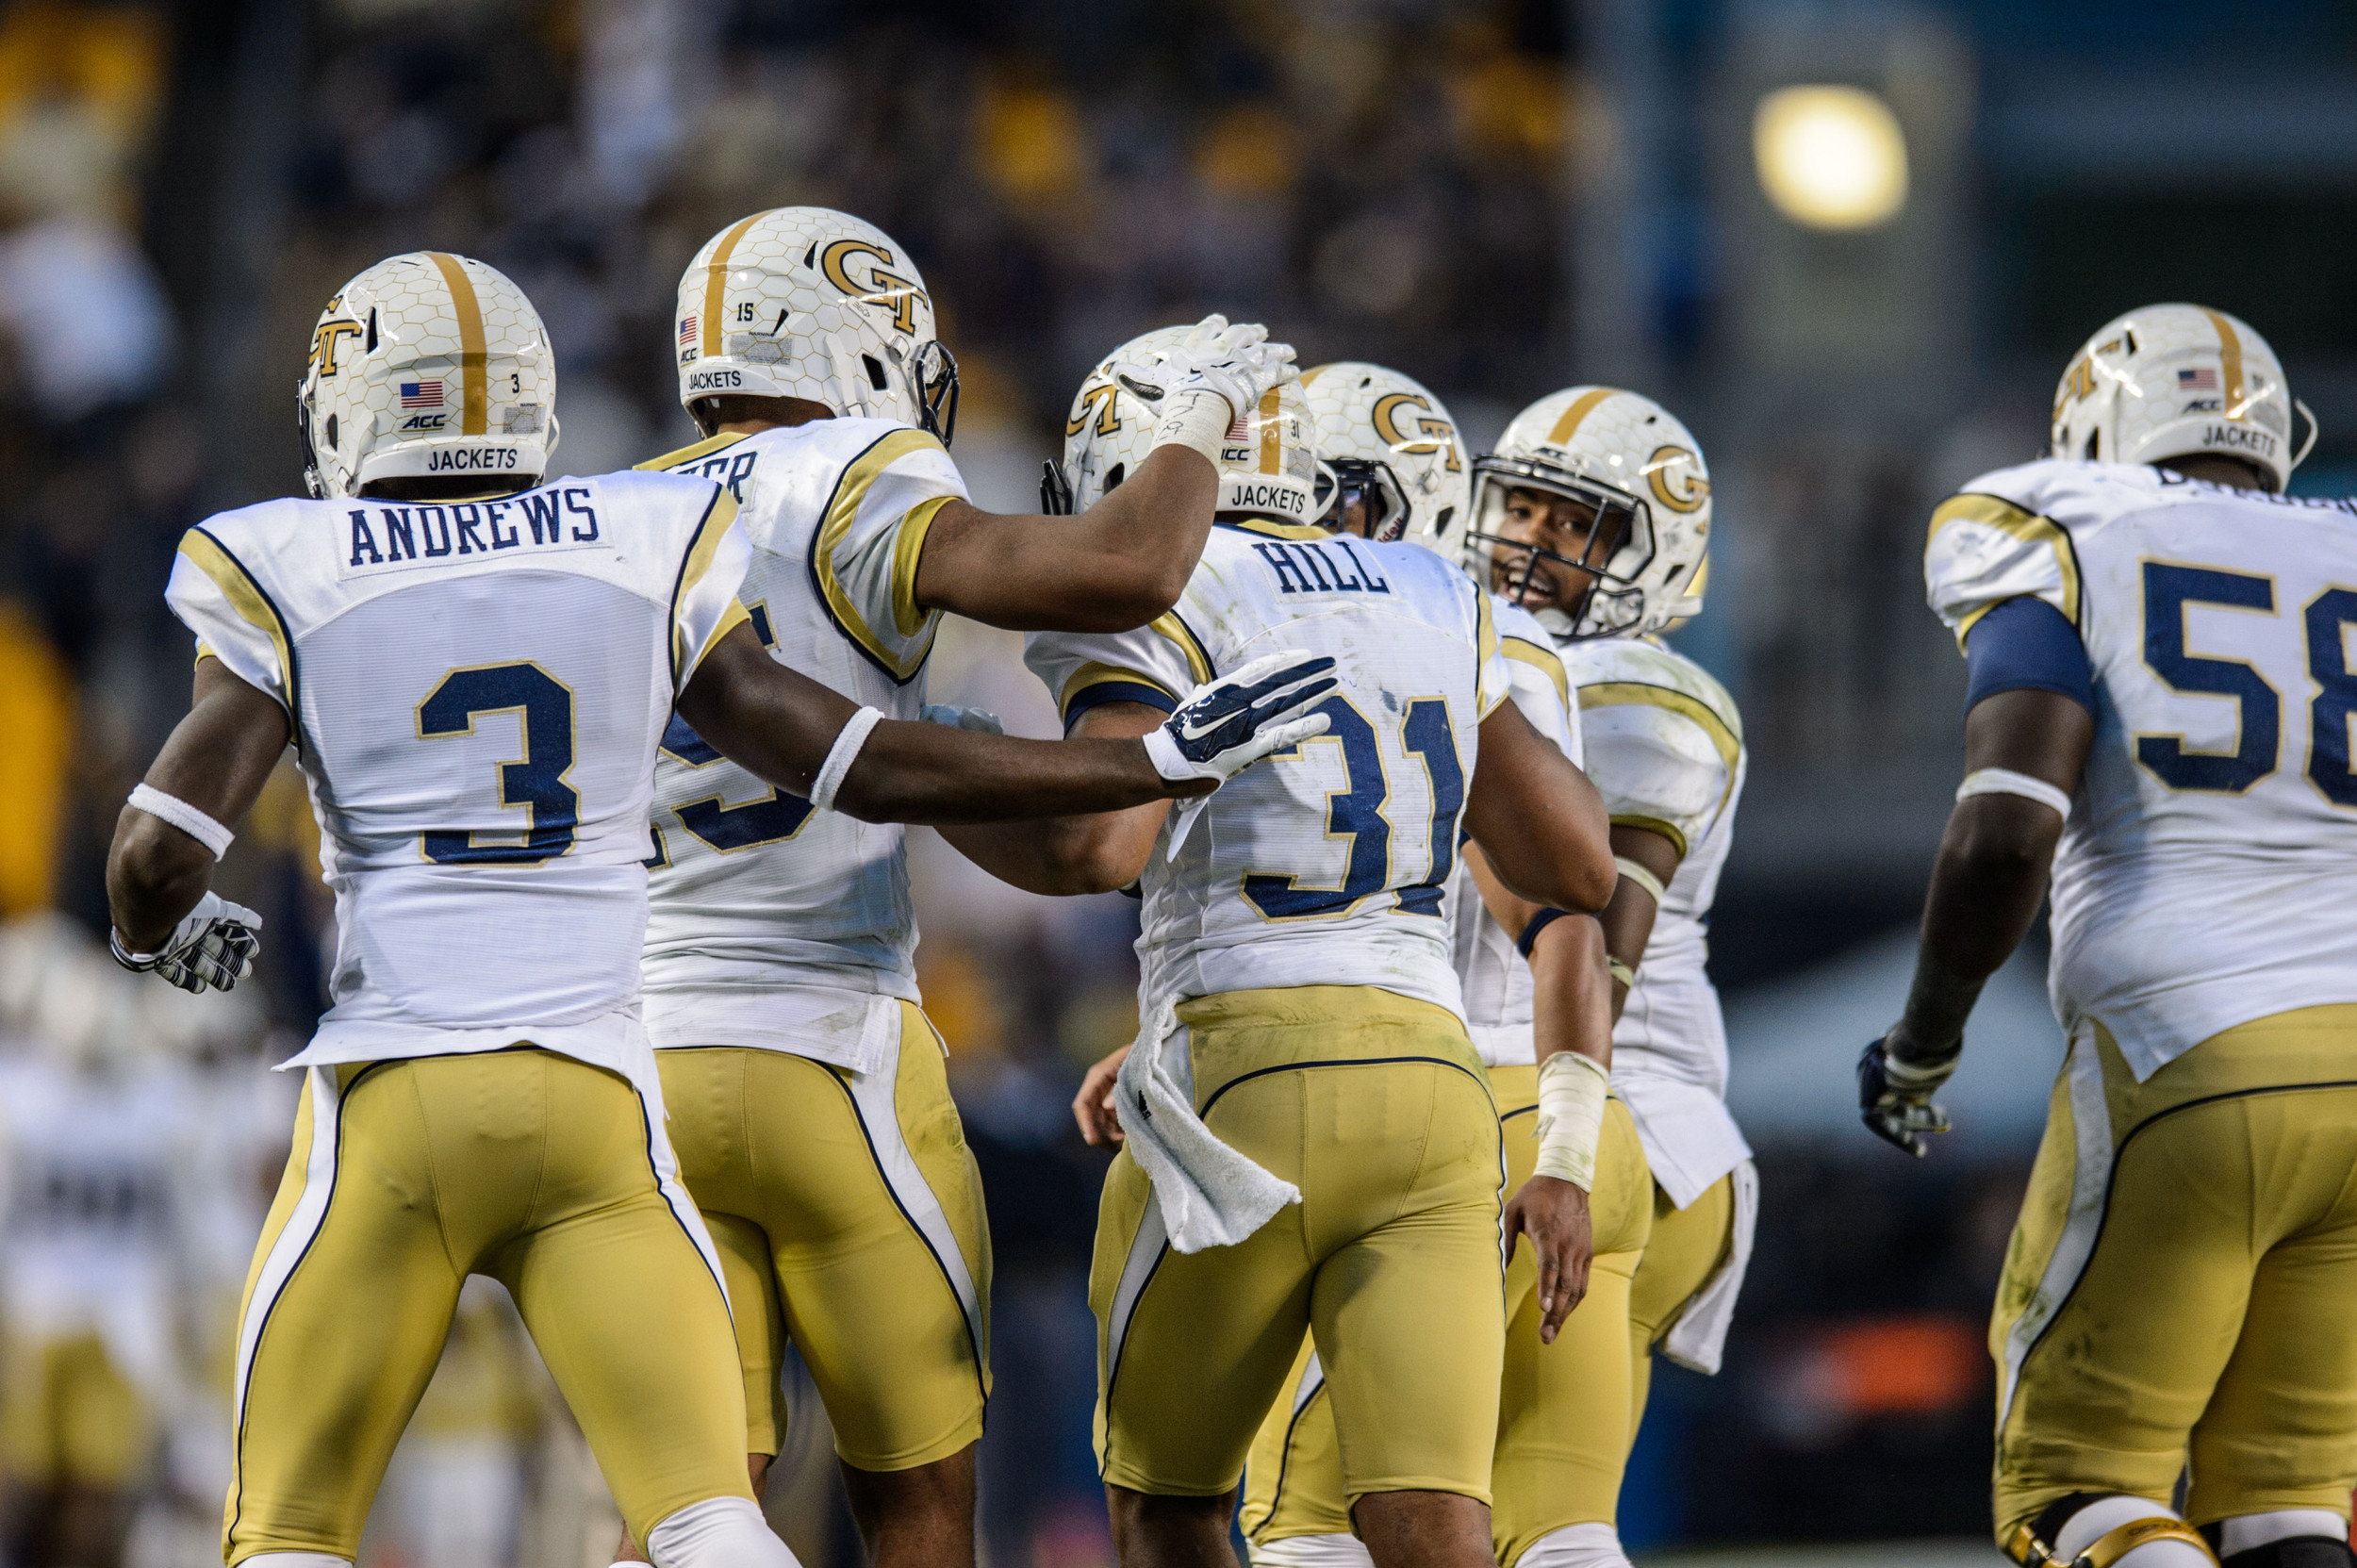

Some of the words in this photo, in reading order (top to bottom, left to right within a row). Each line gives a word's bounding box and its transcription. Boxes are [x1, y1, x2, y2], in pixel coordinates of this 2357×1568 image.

[822, 239, 929, 337] GT
[737, 303, 753, 322] 15
[680, 347, 697, 364] ACC
[511, 373, 519, 393] 3
[688, 371, 742, 389] JACKETS
[402, 414, 446, 429] ACC
[1290, 419, 1300, 439] 31
[1372, 392, 1461, 472] GT
[2202, 425, 2276, 458] JACKETS
[429, 449, 518, 470] JACKETS
[1232, 485, 1306, 514] JACKETS
[348, 487, 600, 567] ANDREWS
[1250, 540, 1391, 595] HILL
[413, 658, 582, 867] 3
[1238, 691, 1468, 924] 31
